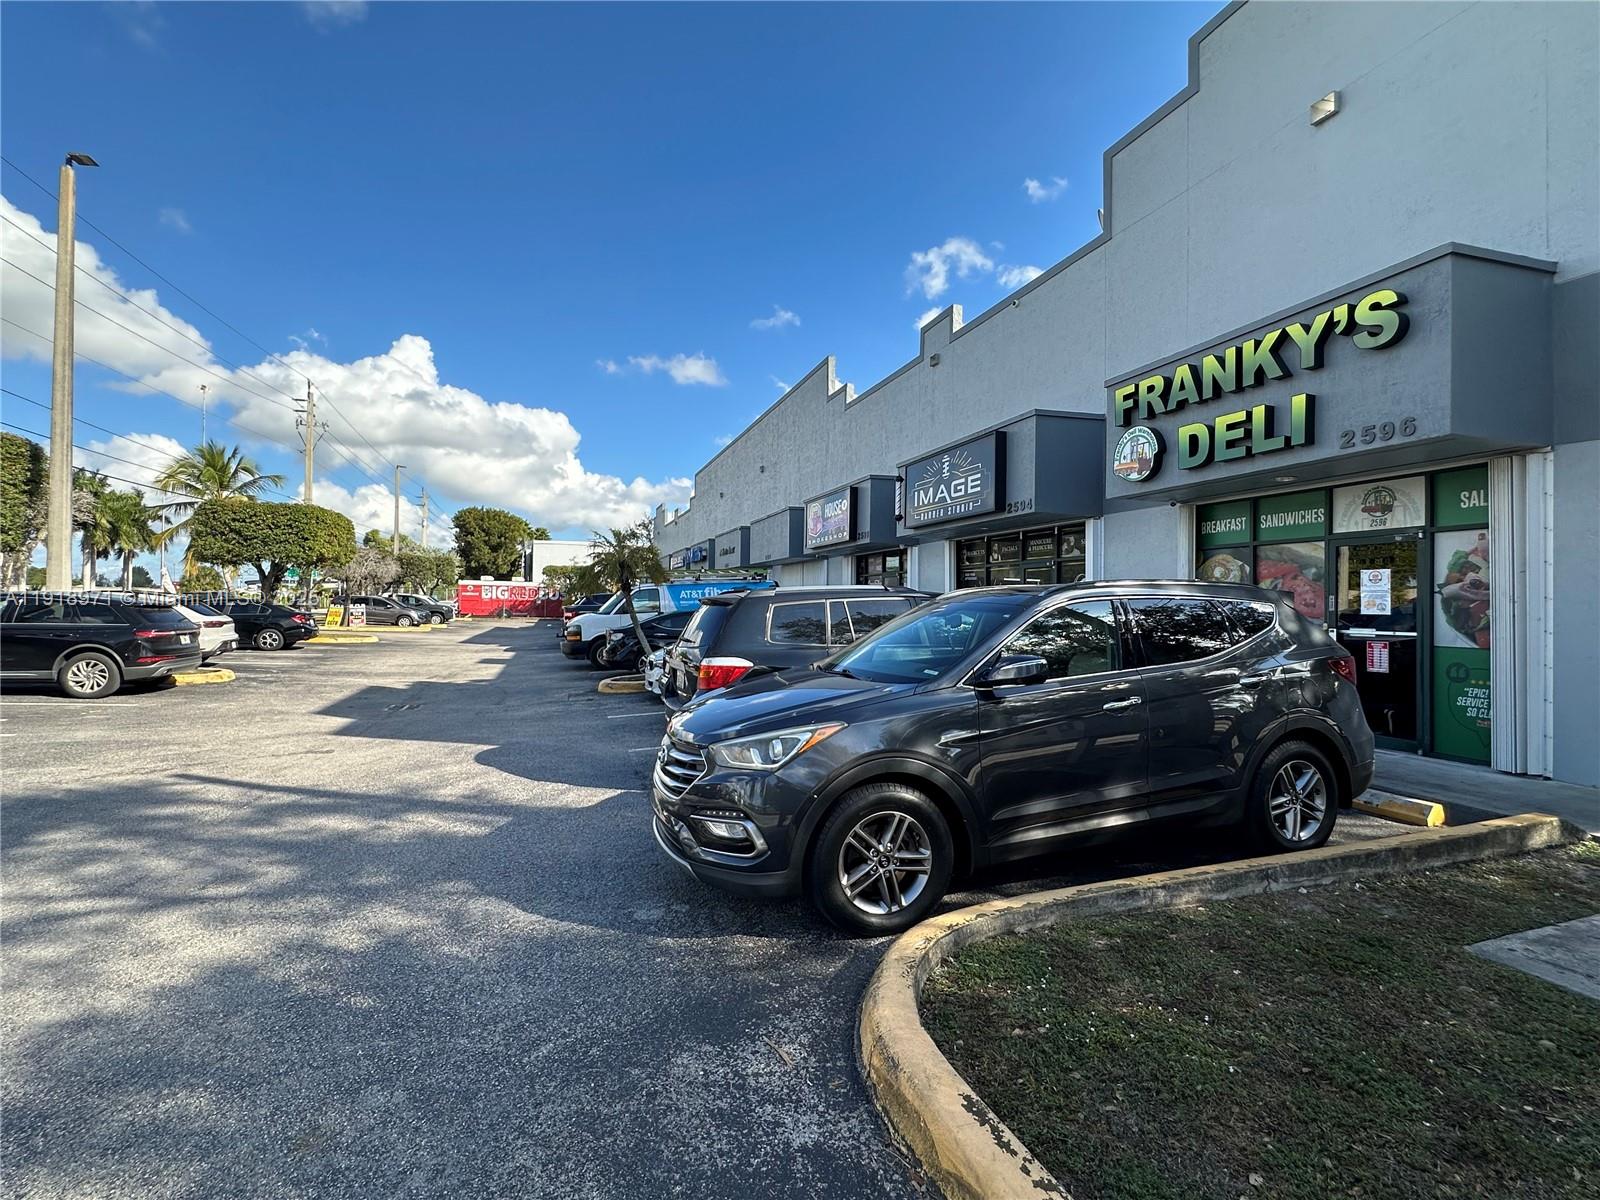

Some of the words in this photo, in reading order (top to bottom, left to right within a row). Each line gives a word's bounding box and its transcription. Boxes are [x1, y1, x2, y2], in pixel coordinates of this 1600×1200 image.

[1114, 289, 1407, 427] FRANKY'S
[1177, 393, 1311, 470] DELI
[1339, 417, 1417, 449] 2596
[914, 473, 981, 507] IMAGE
[824, 499, 842, 518] HOUSE
[948, 502, 973, 515] STUDIO
[1006, 498, 1033, 514] 2594
[1201, 517, 1246, 534] BREAKFAST
[1260, 508, 1325, 528] SANDWICHES
[808, 532, 847, 544] SMOKESHOP
[680, 590, 703, 598] AT&T
[704, 586, 735, 597] fib
[1456, 697, 1489, 708] SERVICE
[1466, 707, 1477, 716] SO
